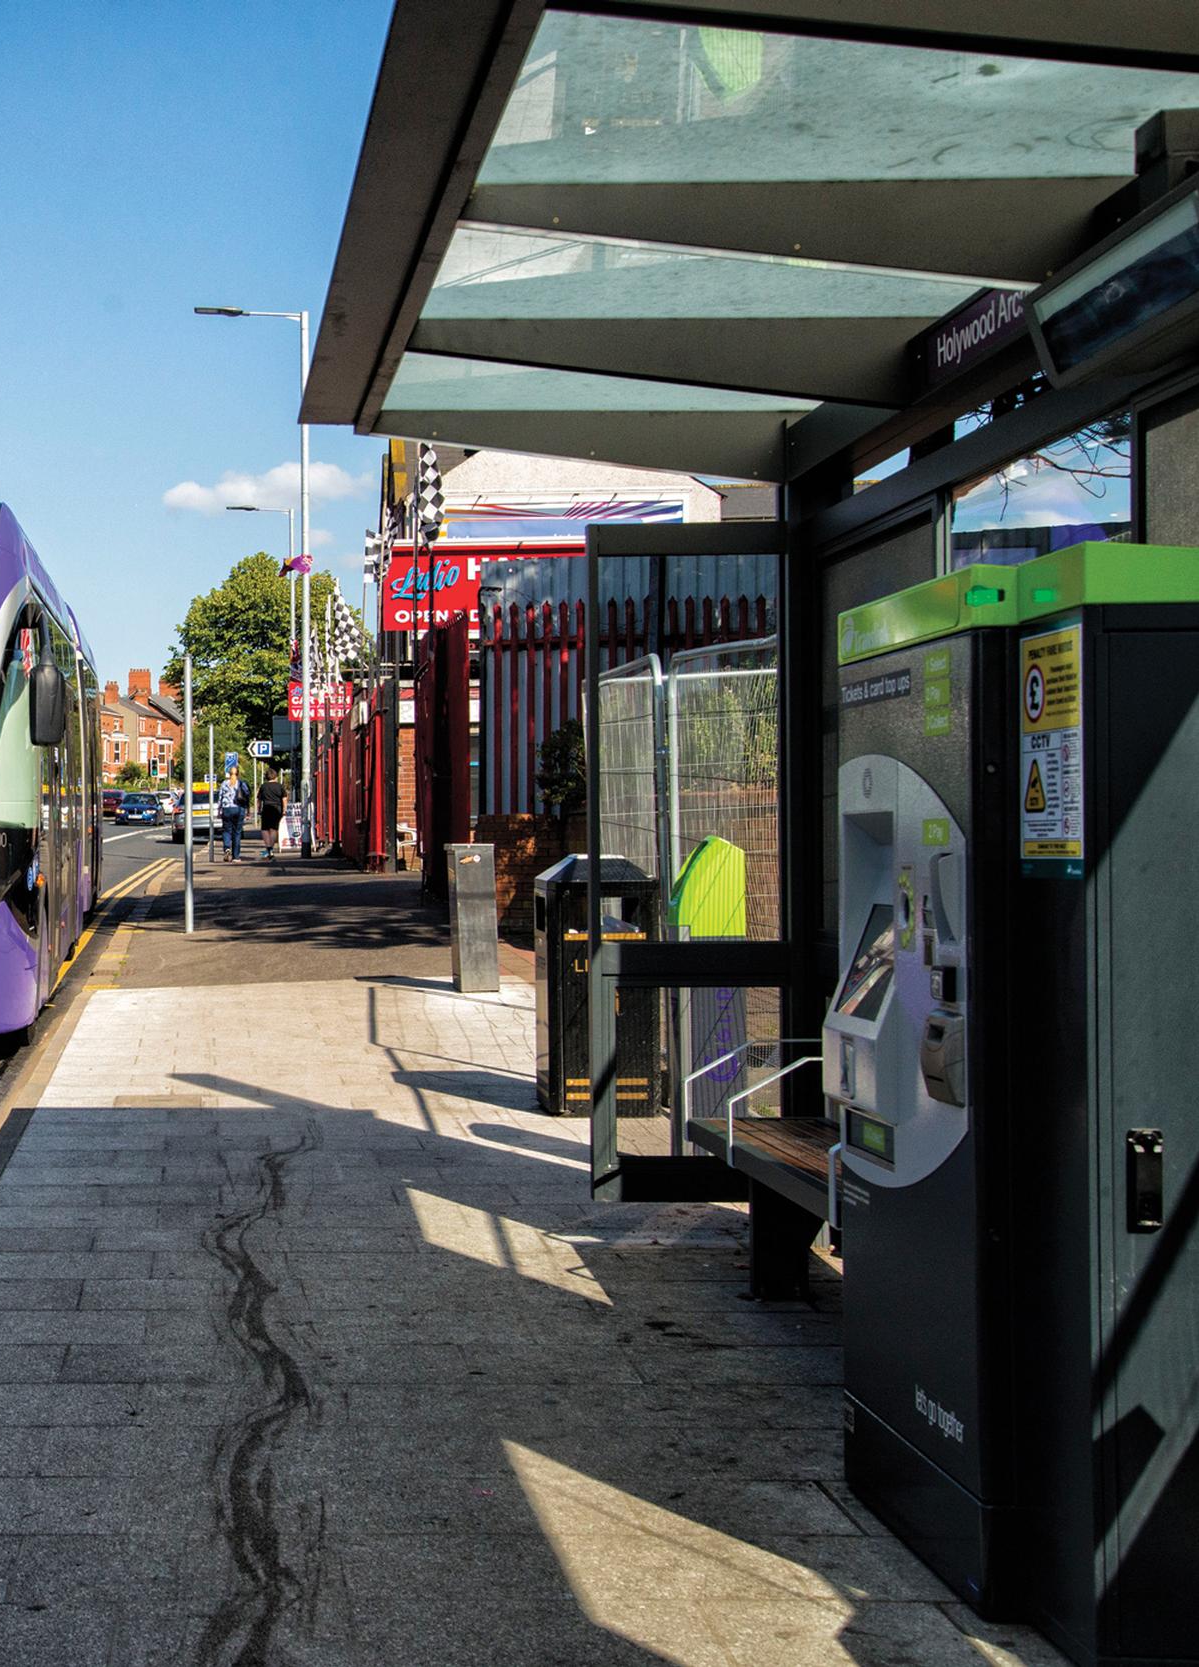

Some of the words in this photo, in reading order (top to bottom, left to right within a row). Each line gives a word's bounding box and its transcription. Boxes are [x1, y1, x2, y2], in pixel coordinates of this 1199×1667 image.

[937, 300, 995, 368] Holywood
[997, 291, 1024, 329] Arc
[394, 609, 449, 624] OPEN
[841, 682, 863, 703] Tickets
[864, 681, 869, 698] &
[869, 677, 884, 696] card
[885, 675, 897, 696] top
[897, 674, 910, 694] ups
[291, 696, 315, 705] CR
[291, 709, 315, 718] VN
[259, 744, 268, 754] P
[1031, 734, 1051, 749] CCTV
[928, 1399, 937, 1426] go
[937, 1401, 964, 1444] together
